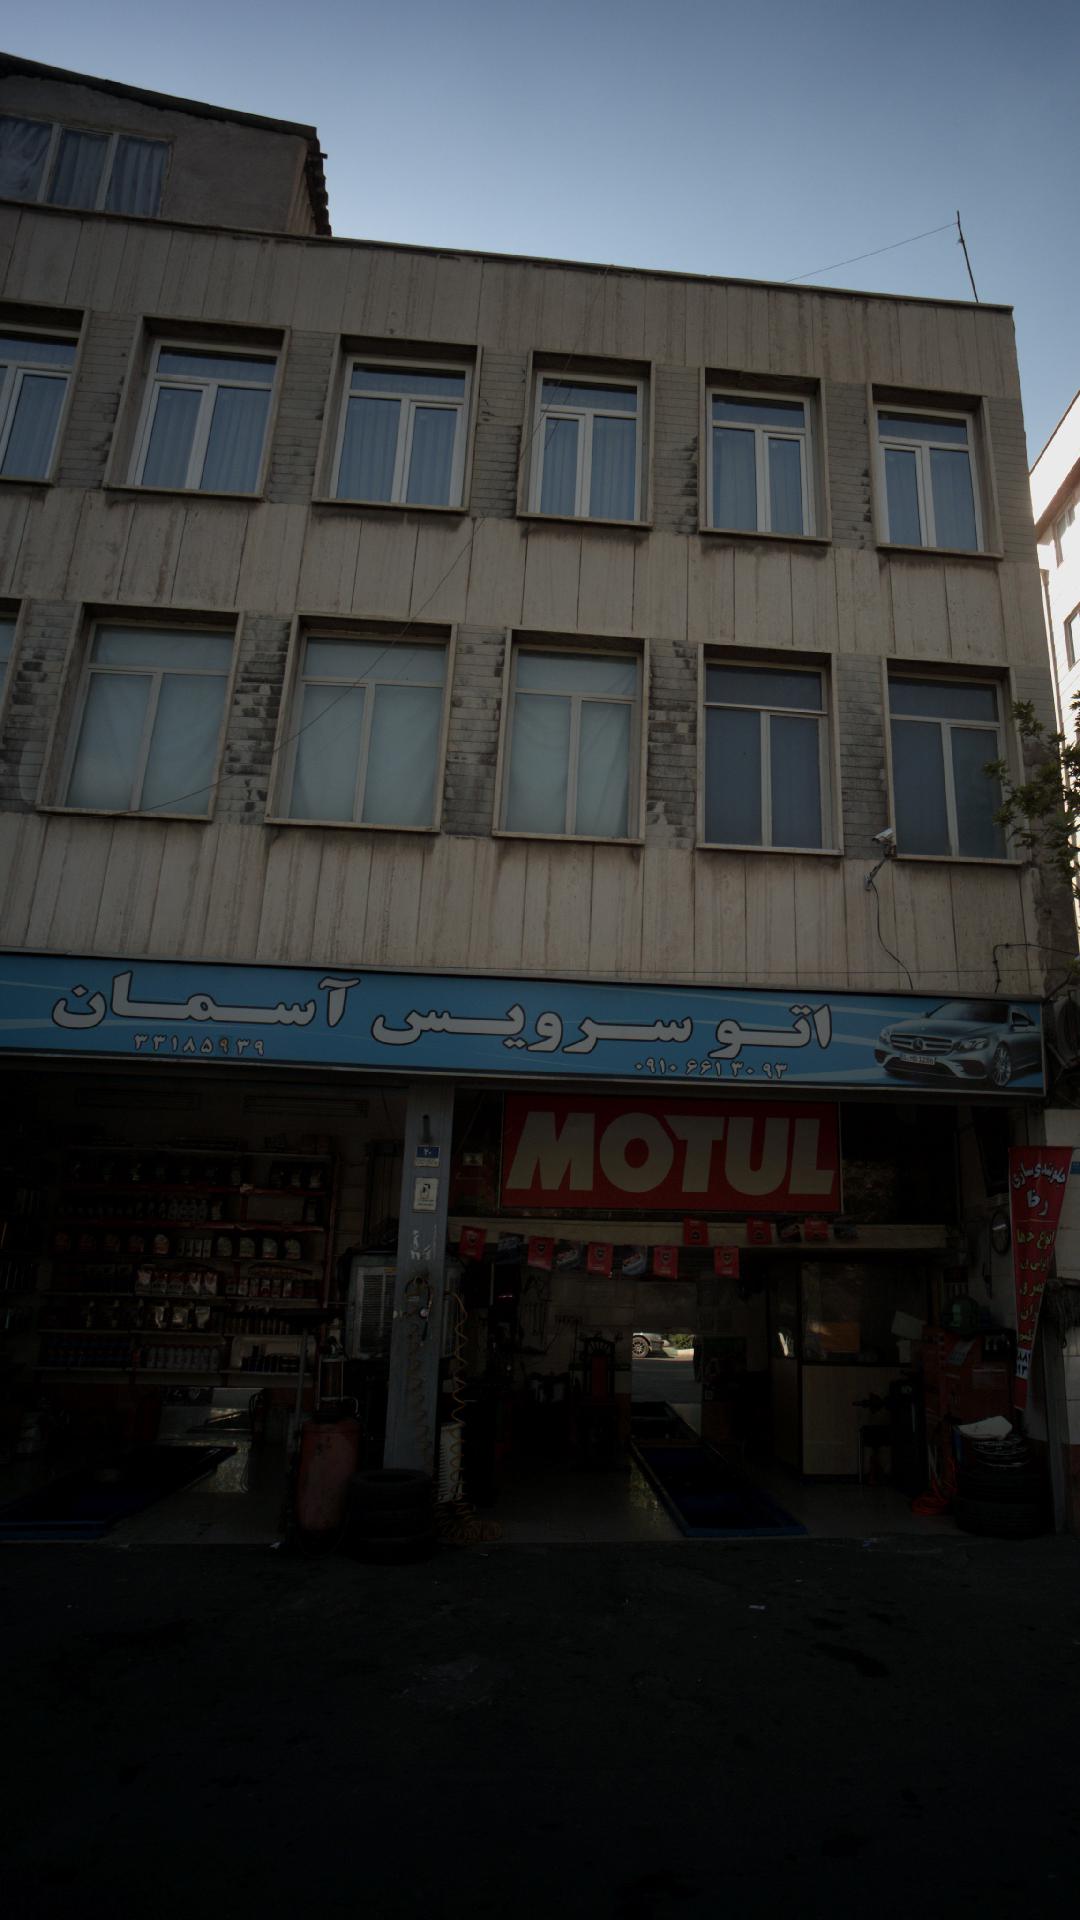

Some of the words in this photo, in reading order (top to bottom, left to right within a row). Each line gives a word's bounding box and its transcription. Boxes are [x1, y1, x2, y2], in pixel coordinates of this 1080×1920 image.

[51, 970, 360, 1029] آسمان
[371, 1003, 693, 1055] سرویس
[708, 1003, 832, 1059] اتو
[504, 1111, 835, 1196] MOTUL
